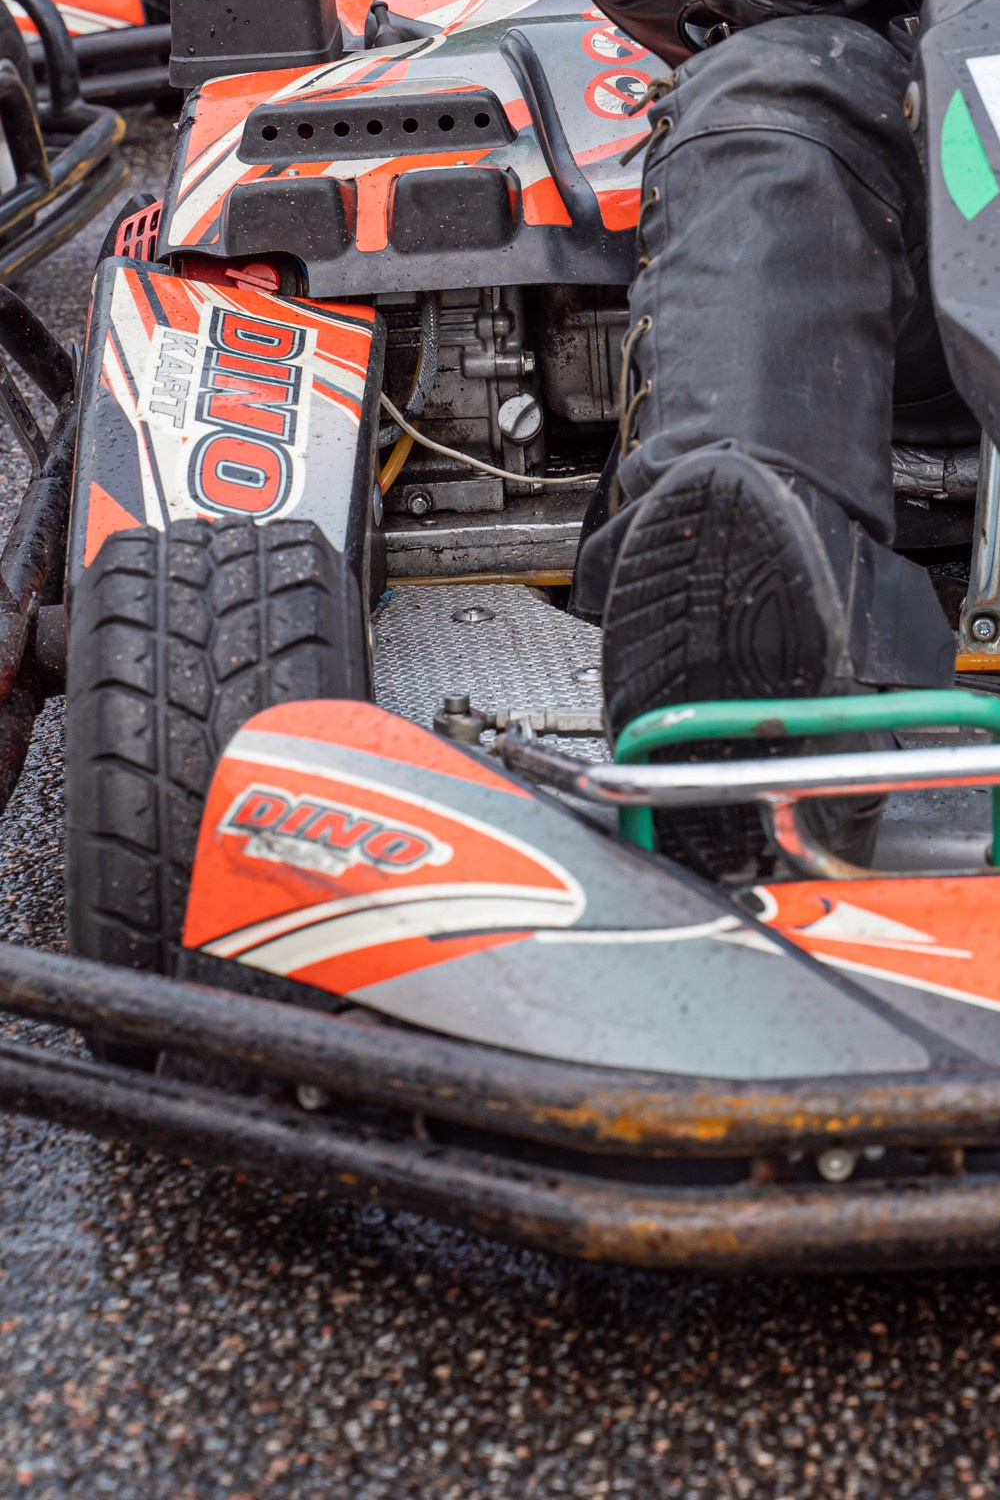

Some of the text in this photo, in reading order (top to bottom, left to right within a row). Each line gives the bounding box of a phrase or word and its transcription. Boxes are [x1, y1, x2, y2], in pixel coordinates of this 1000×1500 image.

[149, 331, 199, 430] KART
[187, 305, 307, 521] DINO
[227, 790, 434, 868] DINO
